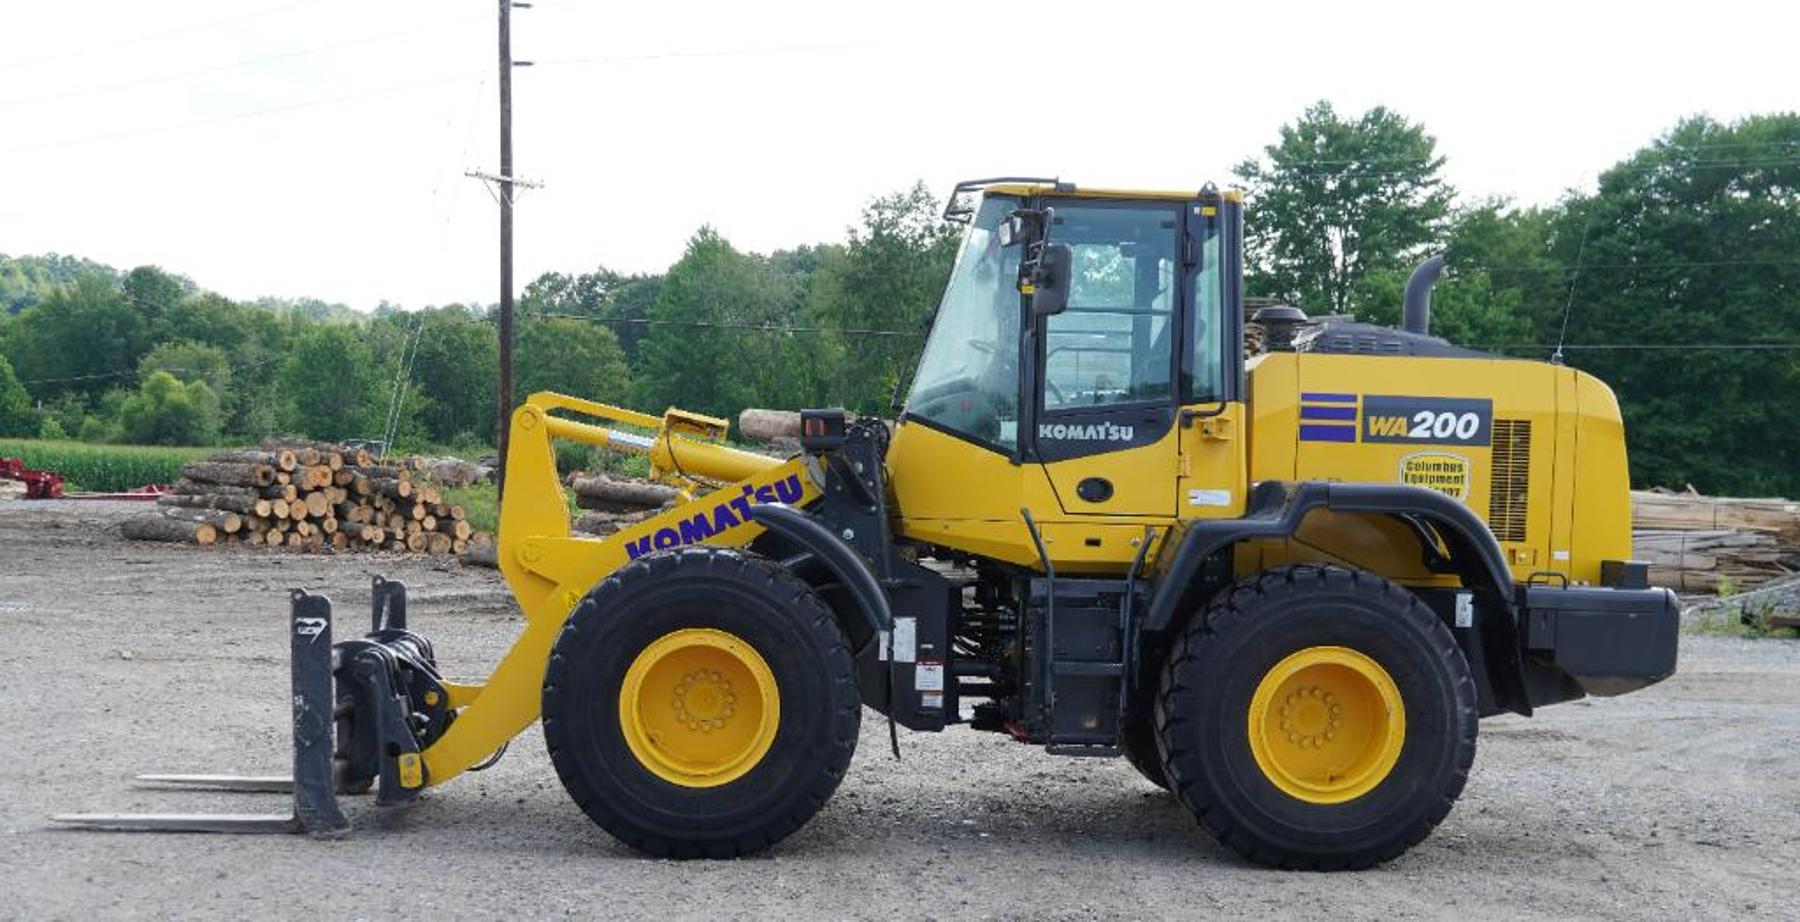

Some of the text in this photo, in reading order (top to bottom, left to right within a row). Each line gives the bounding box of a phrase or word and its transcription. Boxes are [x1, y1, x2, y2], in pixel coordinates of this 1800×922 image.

[1039, 421, 1134, 440] KOMATSU
[1369, 411, 1480, 439] WA200
[1406, 461, 1464, 472] Columbus
[1404, 472, 1464, 484] Equipment
